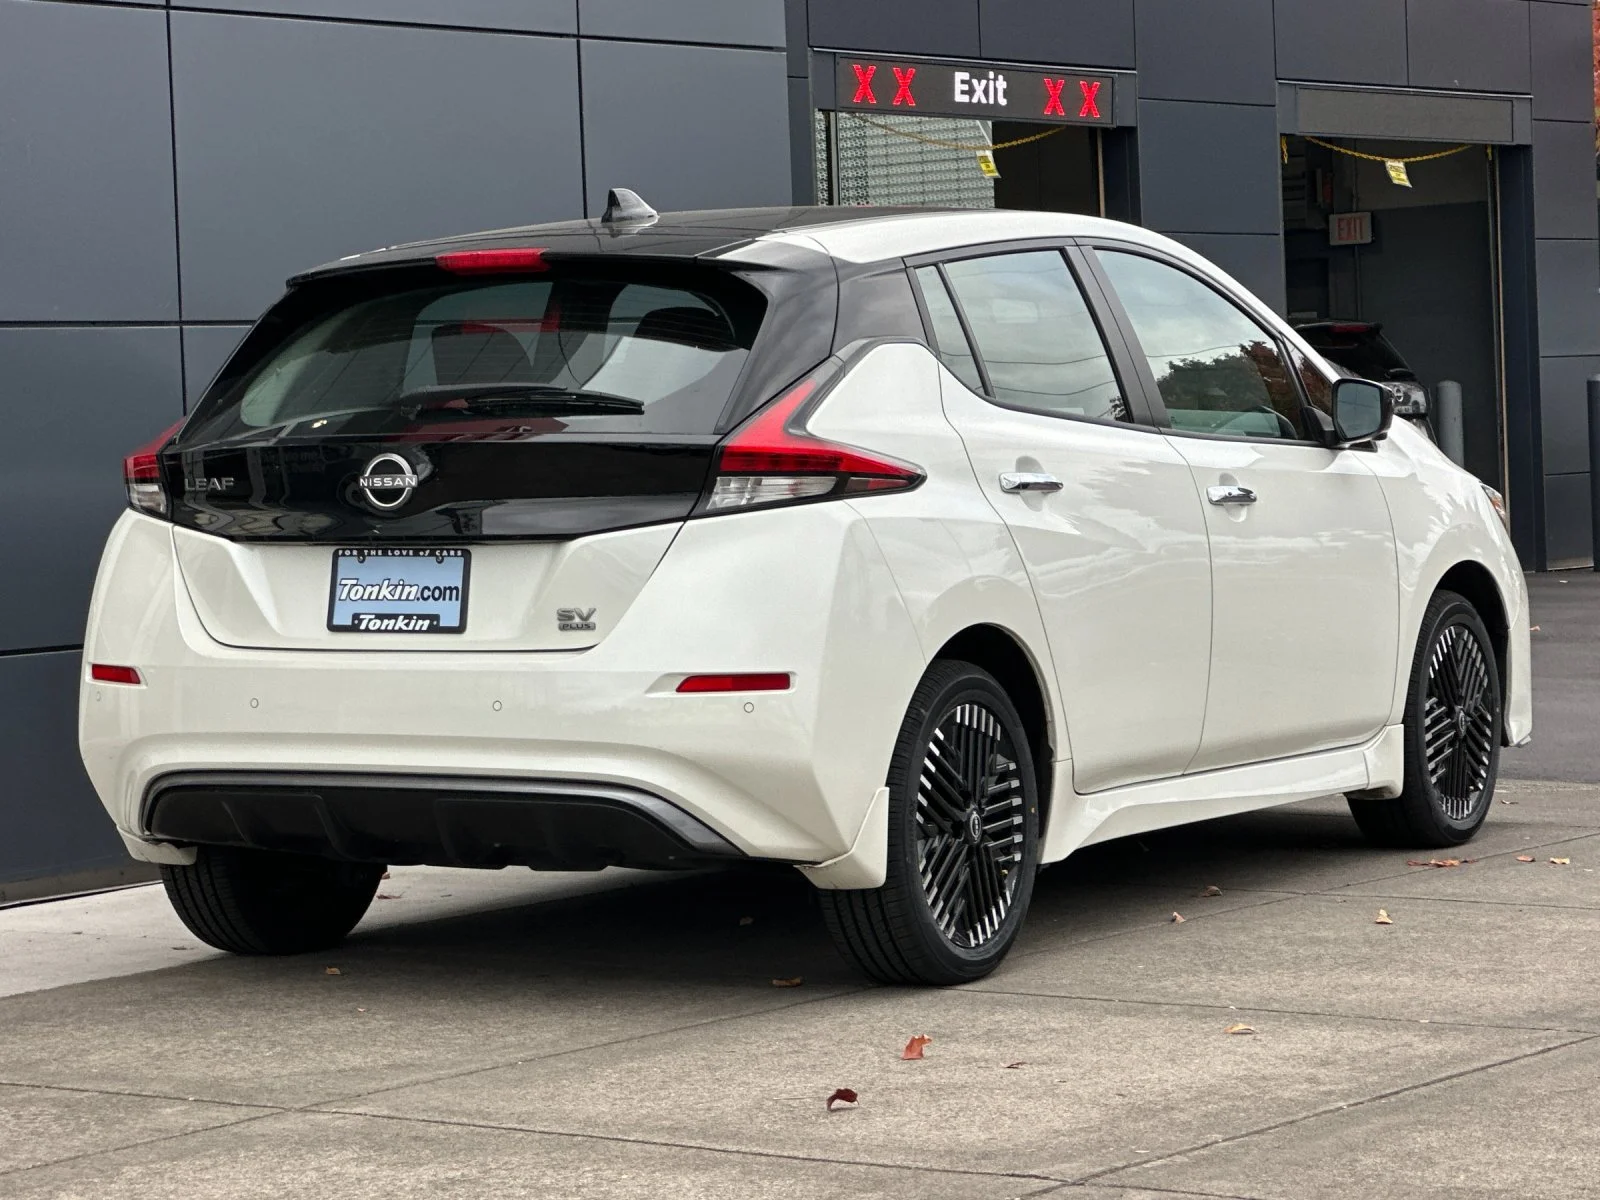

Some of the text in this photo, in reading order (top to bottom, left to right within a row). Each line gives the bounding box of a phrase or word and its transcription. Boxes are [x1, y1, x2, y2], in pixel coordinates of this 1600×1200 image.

[953, 71, 1008, 107] Exit
[1336, 216, 1366, 241] EXIT
[184, 477, 235, 491] LEAF
[359, 476, 418, 488] NISSAN
[338, 578, 460, 602] Tonkin.com
[359, 613, 431, 631] Tonkin
[556, 607, 597, 621] SV
